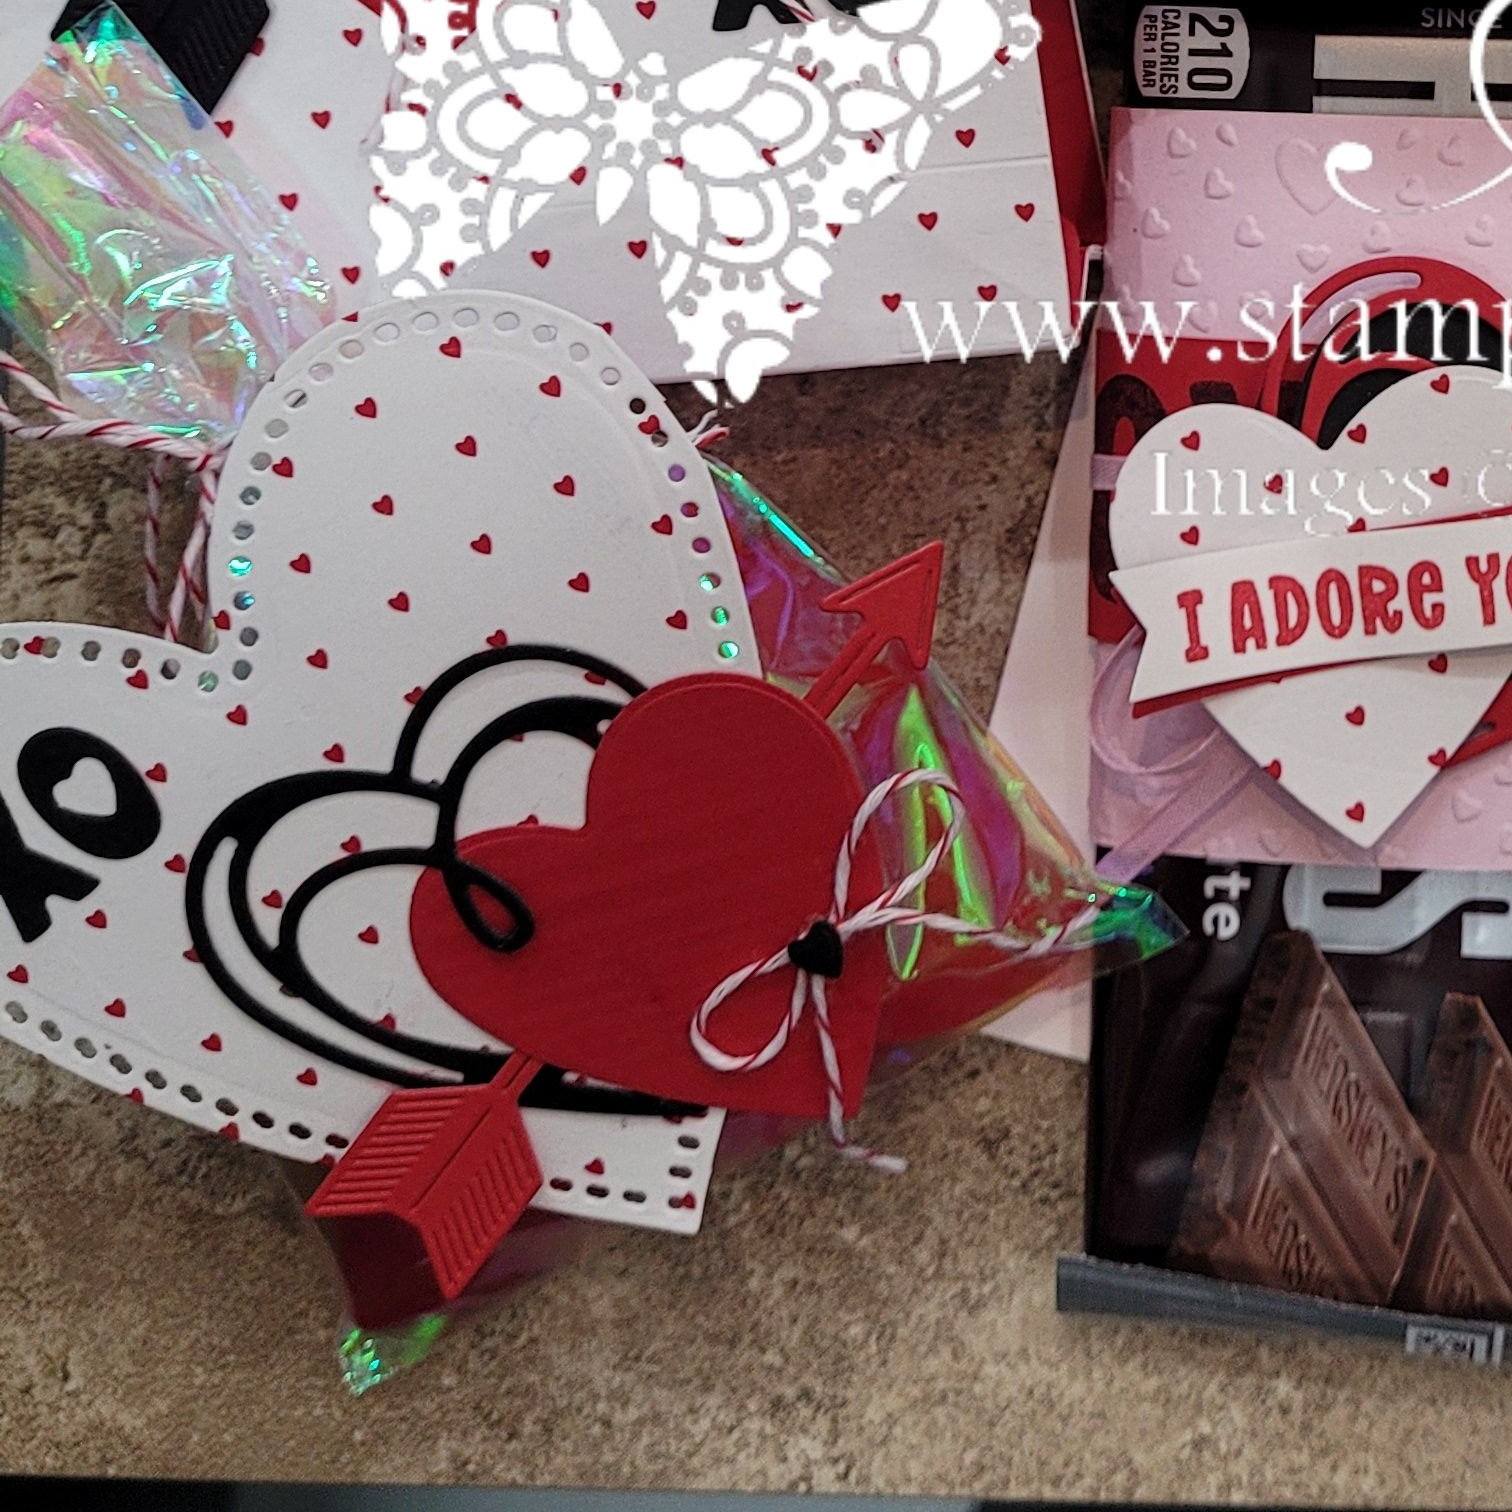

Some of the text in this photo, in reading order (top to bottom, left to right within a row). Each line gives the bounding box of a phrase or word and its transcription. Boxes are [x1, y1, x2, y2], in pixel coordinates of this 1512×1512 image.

[1142, 14, 1158, 43] PER
[1160, 8, 1181, 96] CALORIES
[1187, 14, 1235, 92] 210
[1142, 59, 1157, 88] BAR
[1177, 590, 1210, 663] I
